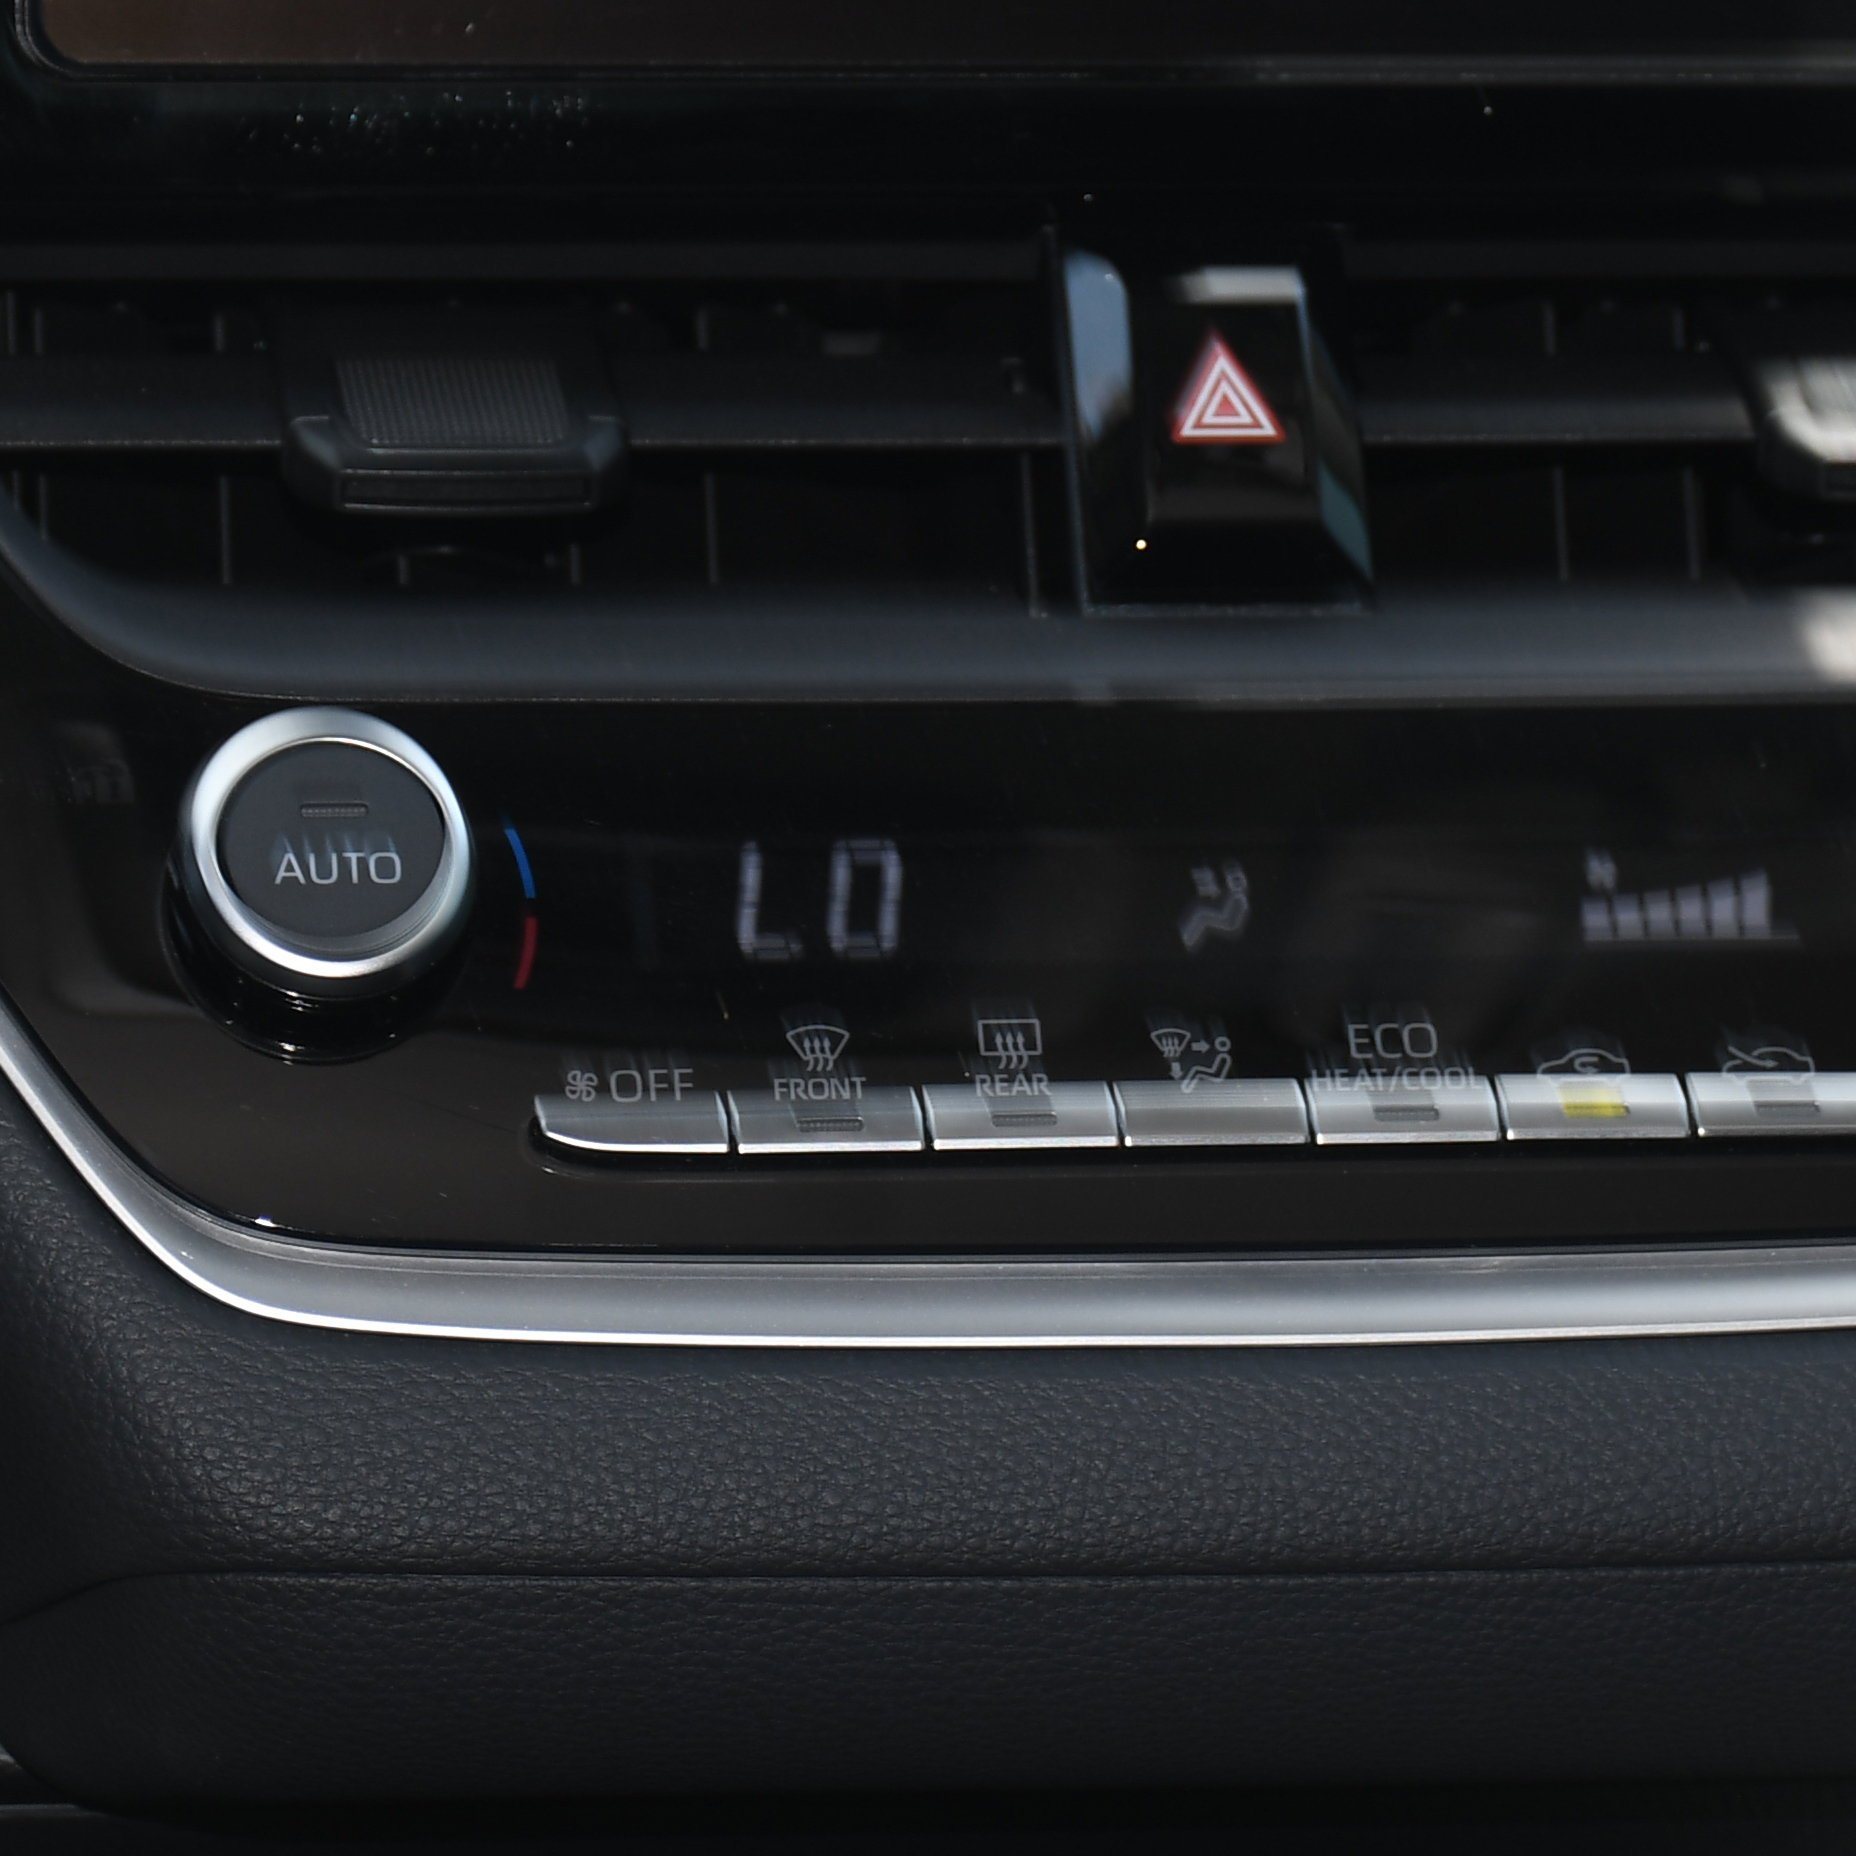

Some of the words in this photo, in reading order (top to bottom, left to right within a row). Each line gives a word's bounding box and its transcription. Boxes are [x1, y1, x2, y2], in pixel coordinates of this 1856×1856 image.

[274, 850, 403, 886] AUTO
[1348, 1022, 1438, 1059] ECO
[610, 1068, 695, 1103] OFF
[773, 1076, 866, 1102] FRONT
[975, 1073, 1052, 1098] REAR
[1311, 1065, 1484, 1094] HEAT/COOL
